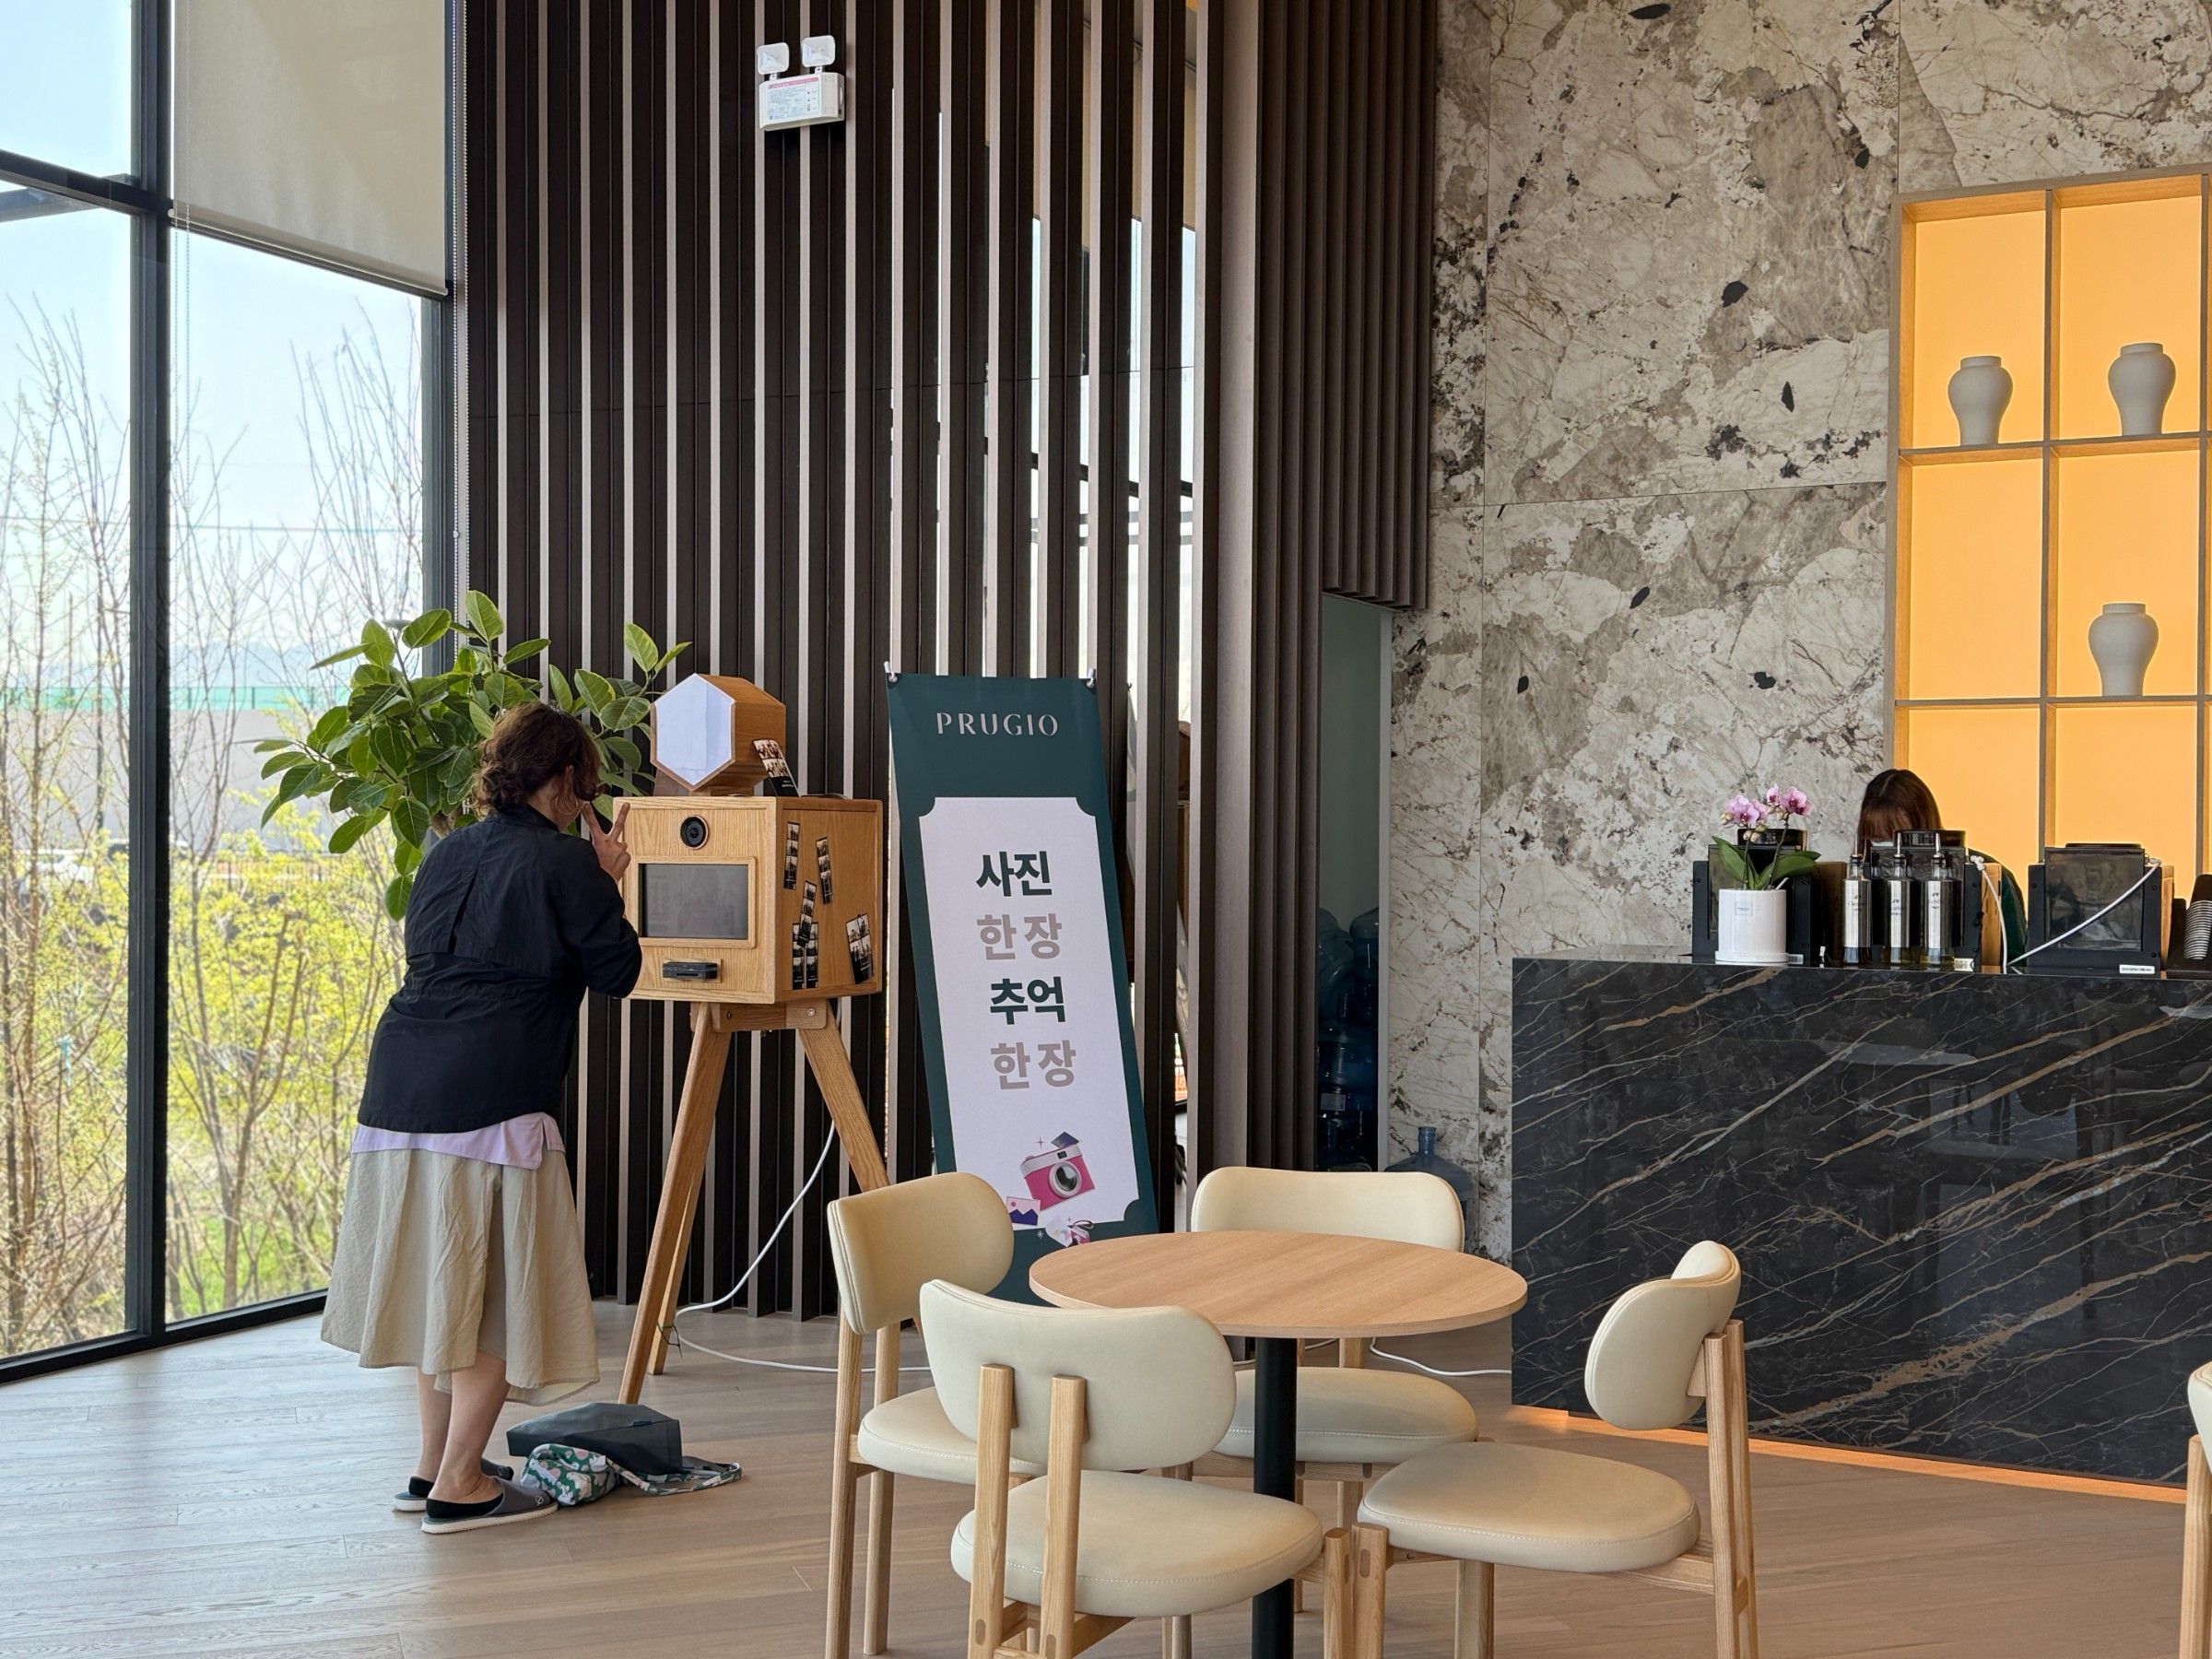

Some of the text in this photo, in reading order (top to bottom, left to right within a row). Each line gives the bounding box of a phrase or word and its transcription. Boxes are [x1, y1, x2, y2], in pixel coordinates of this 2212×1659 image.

[936, 712, 1058, 736] PRUGIO
[975, 851, 1053, 897] 사진
[990, 976, 1066, 1025] 추억
